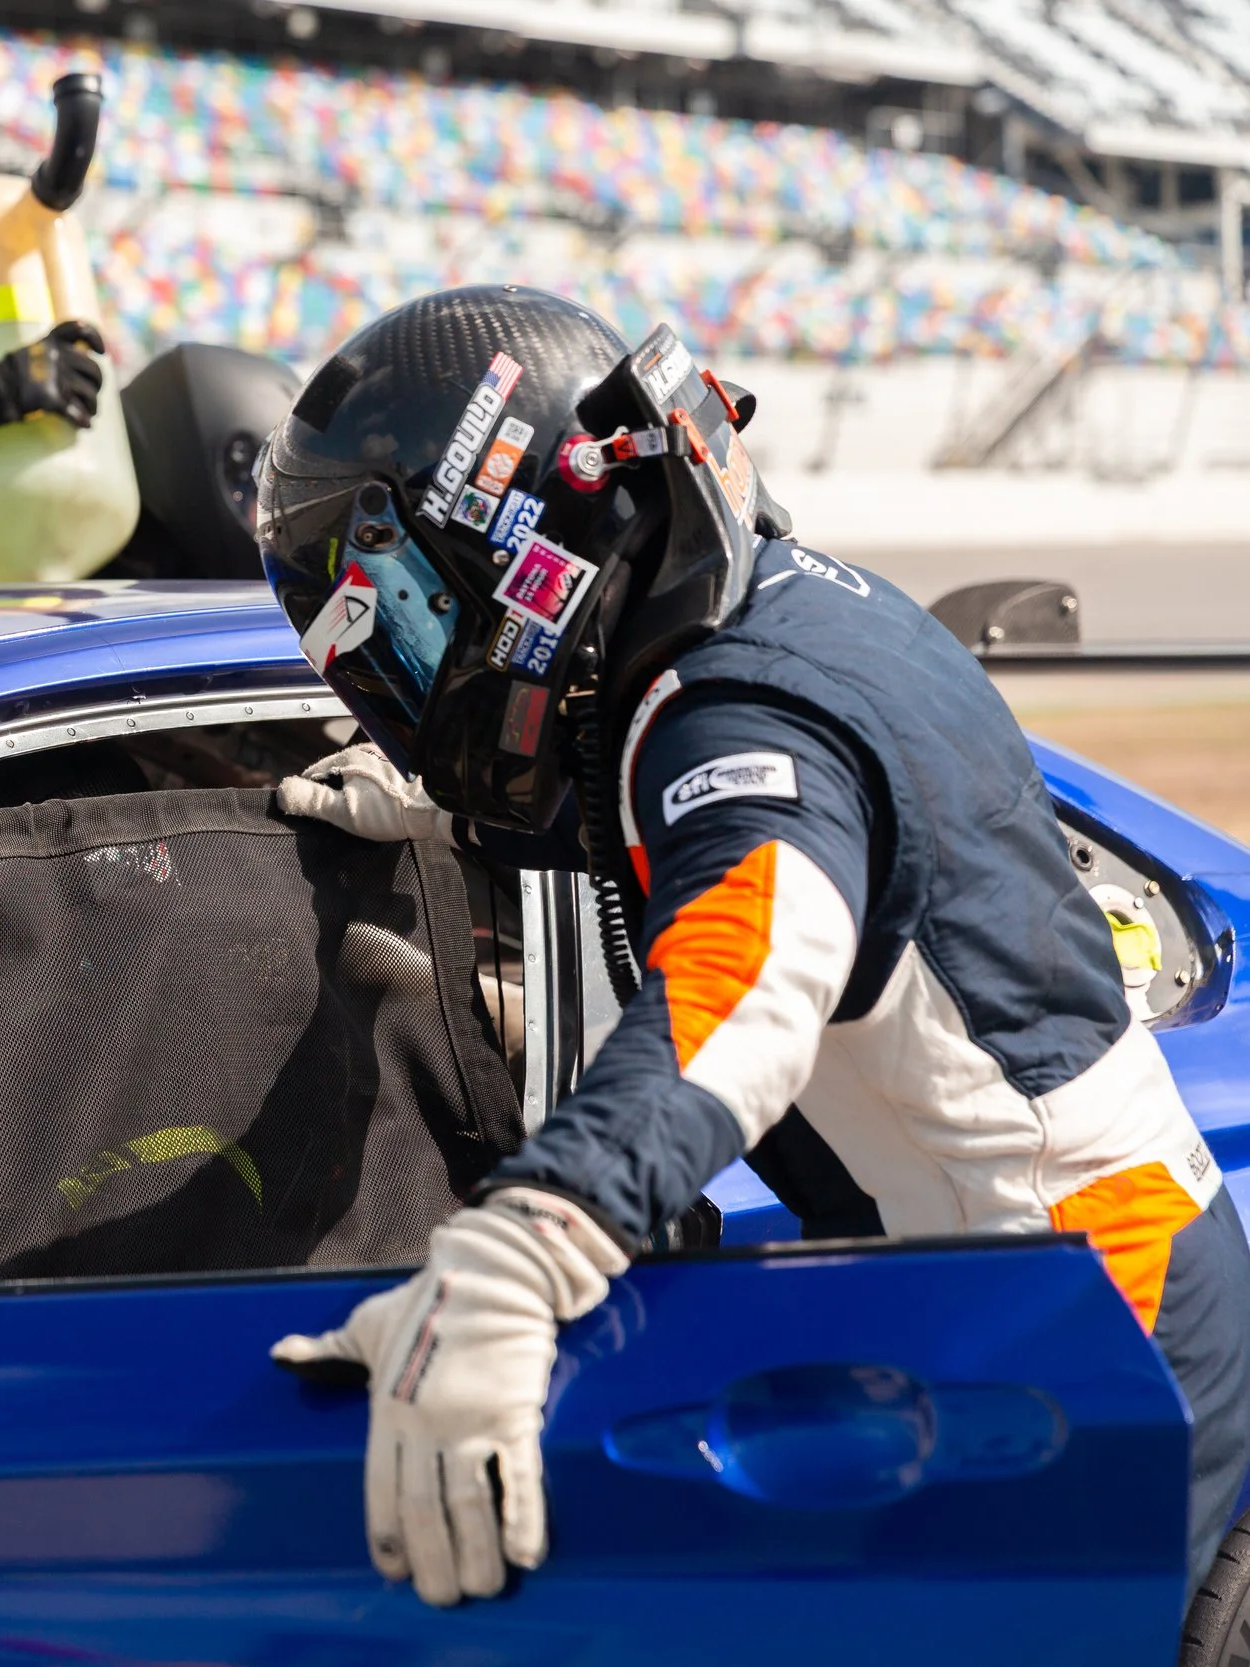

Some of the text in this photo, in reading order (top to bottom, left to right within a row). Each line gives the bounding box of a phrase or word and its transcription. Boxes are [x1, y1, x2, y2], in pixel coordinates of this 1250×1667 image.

[421, 384, 502, 523] H.GOULD
[506, 497, 545, 551] 2022
[490, 619, 520, 667] HOD
